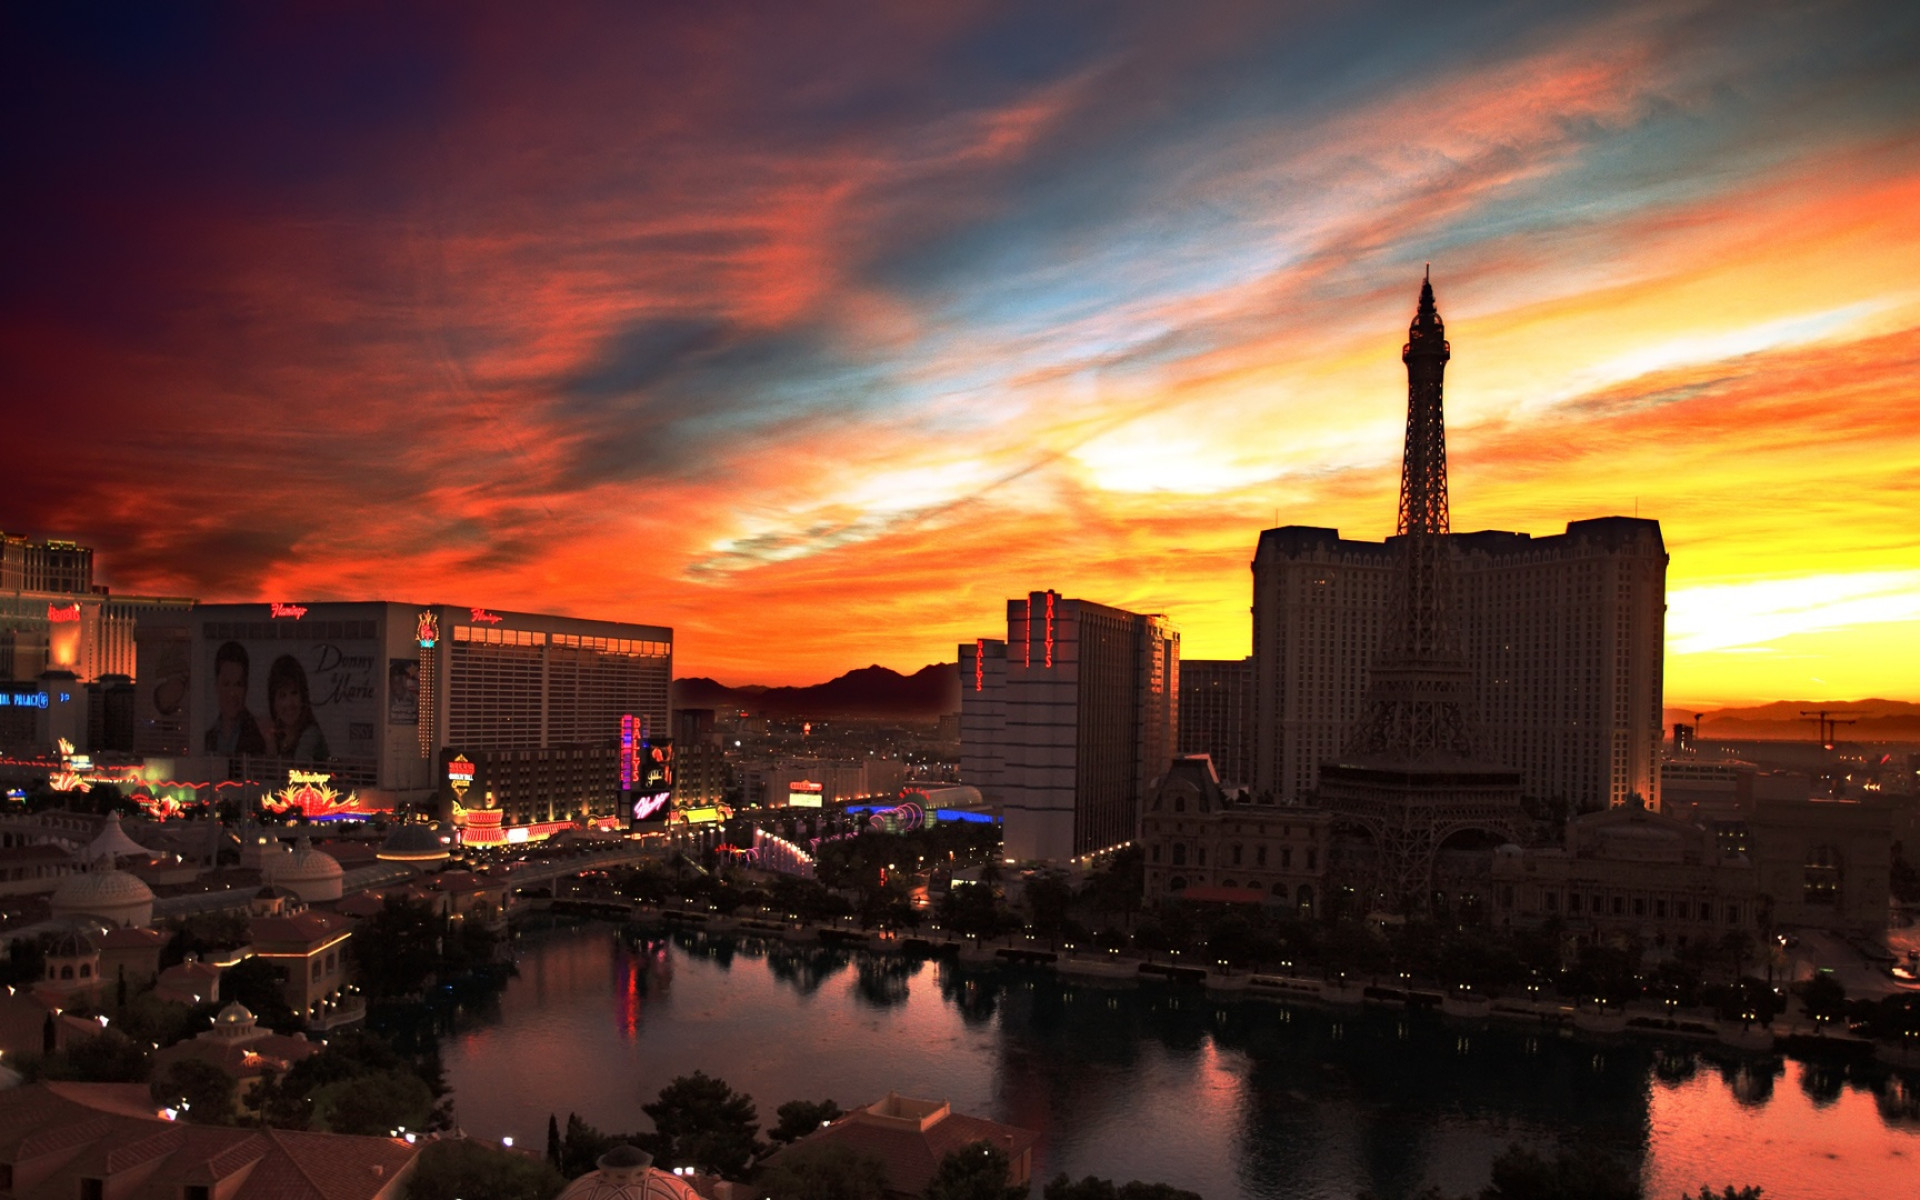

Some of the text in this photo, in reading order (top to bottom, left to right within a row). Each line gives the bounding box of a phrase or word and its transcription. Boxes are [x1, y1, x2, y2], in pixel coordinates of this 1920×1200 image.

[271, 603, 308, 620] Flamingo
[310, 643, 375, 674] Donny
[309, 673, 375, 706] Marie
